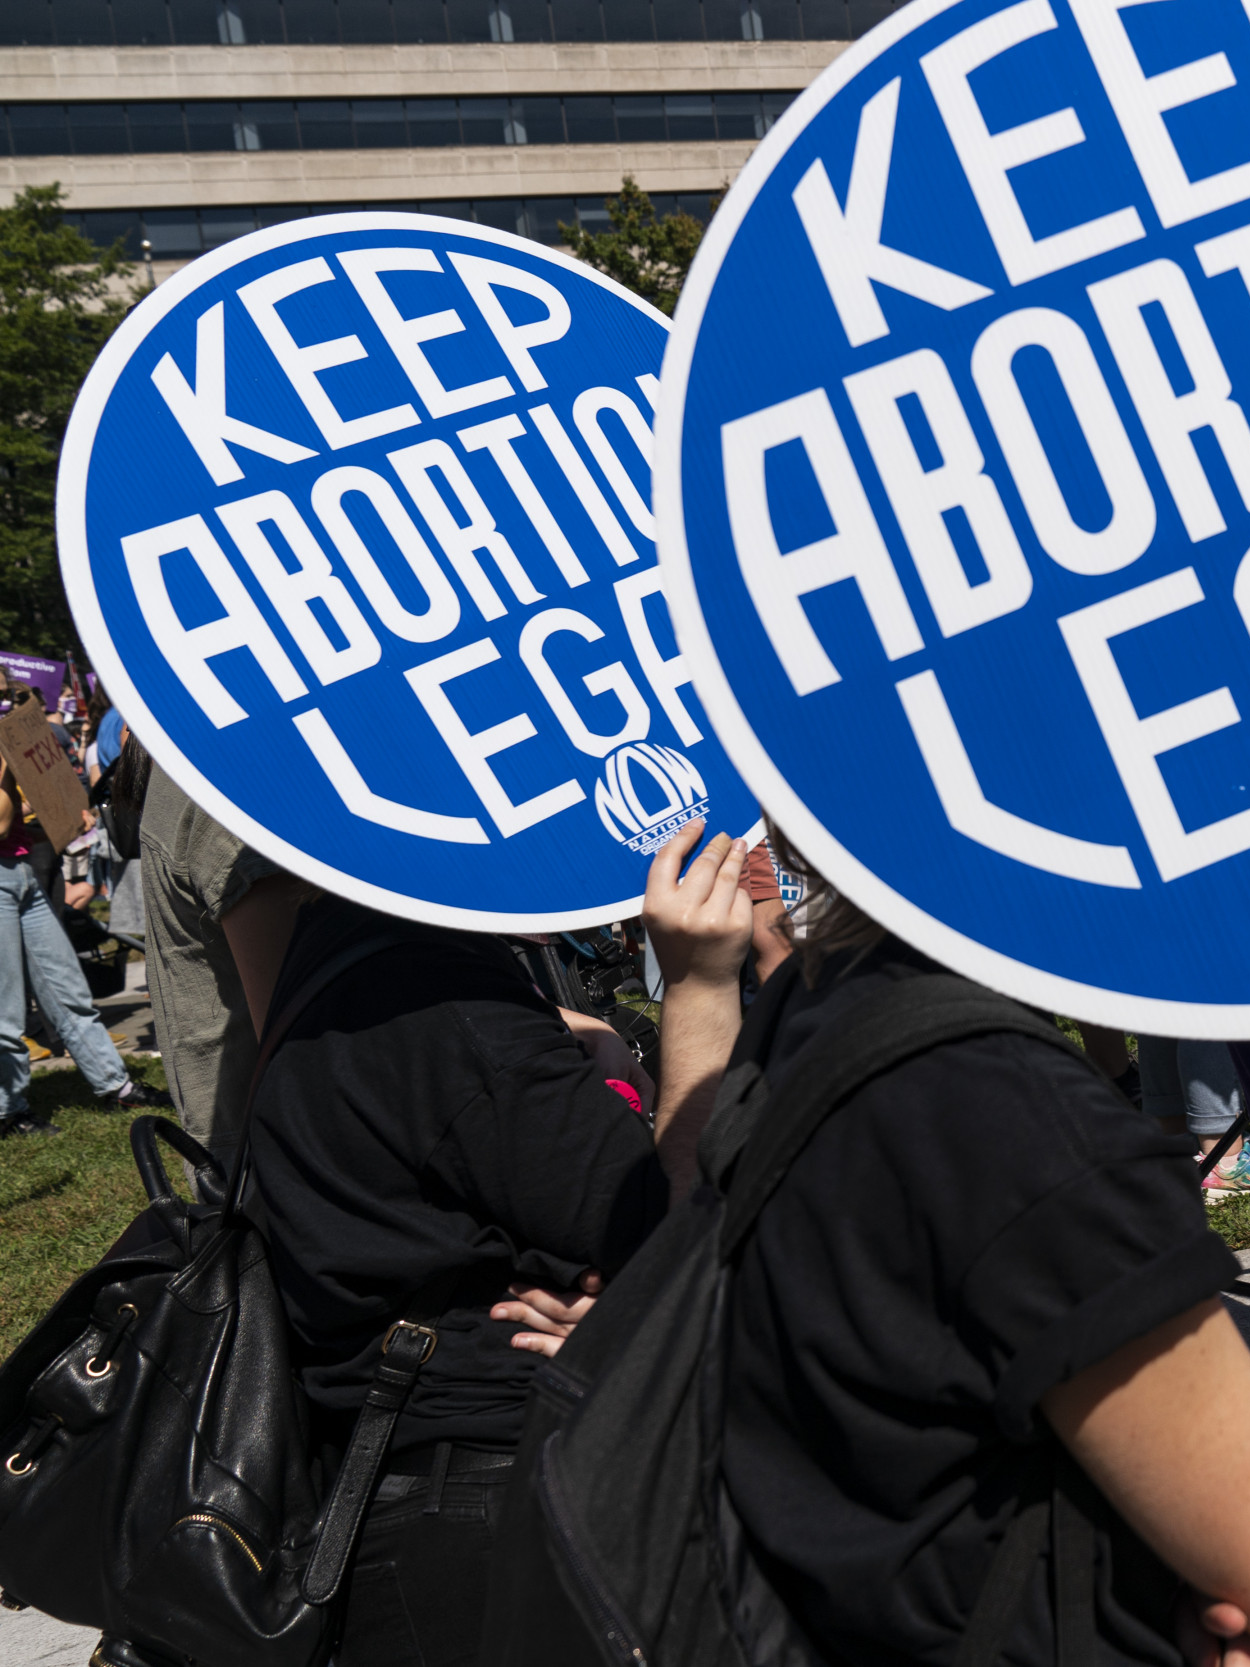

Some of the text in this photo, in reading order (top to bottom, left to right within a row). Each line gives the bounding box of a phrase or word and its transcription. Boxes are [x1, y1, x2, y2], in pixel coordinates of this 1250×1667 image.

[150, 247, 572, 487] KEEP
[120, 373, 661, 729] ABORTIO
[23, 732, 62, 775] TEXA
[292, 564, 705, 844] LEGA
[594, 742, 709, 843] NOW
[628, 804, 709, 850] NATIONAL
